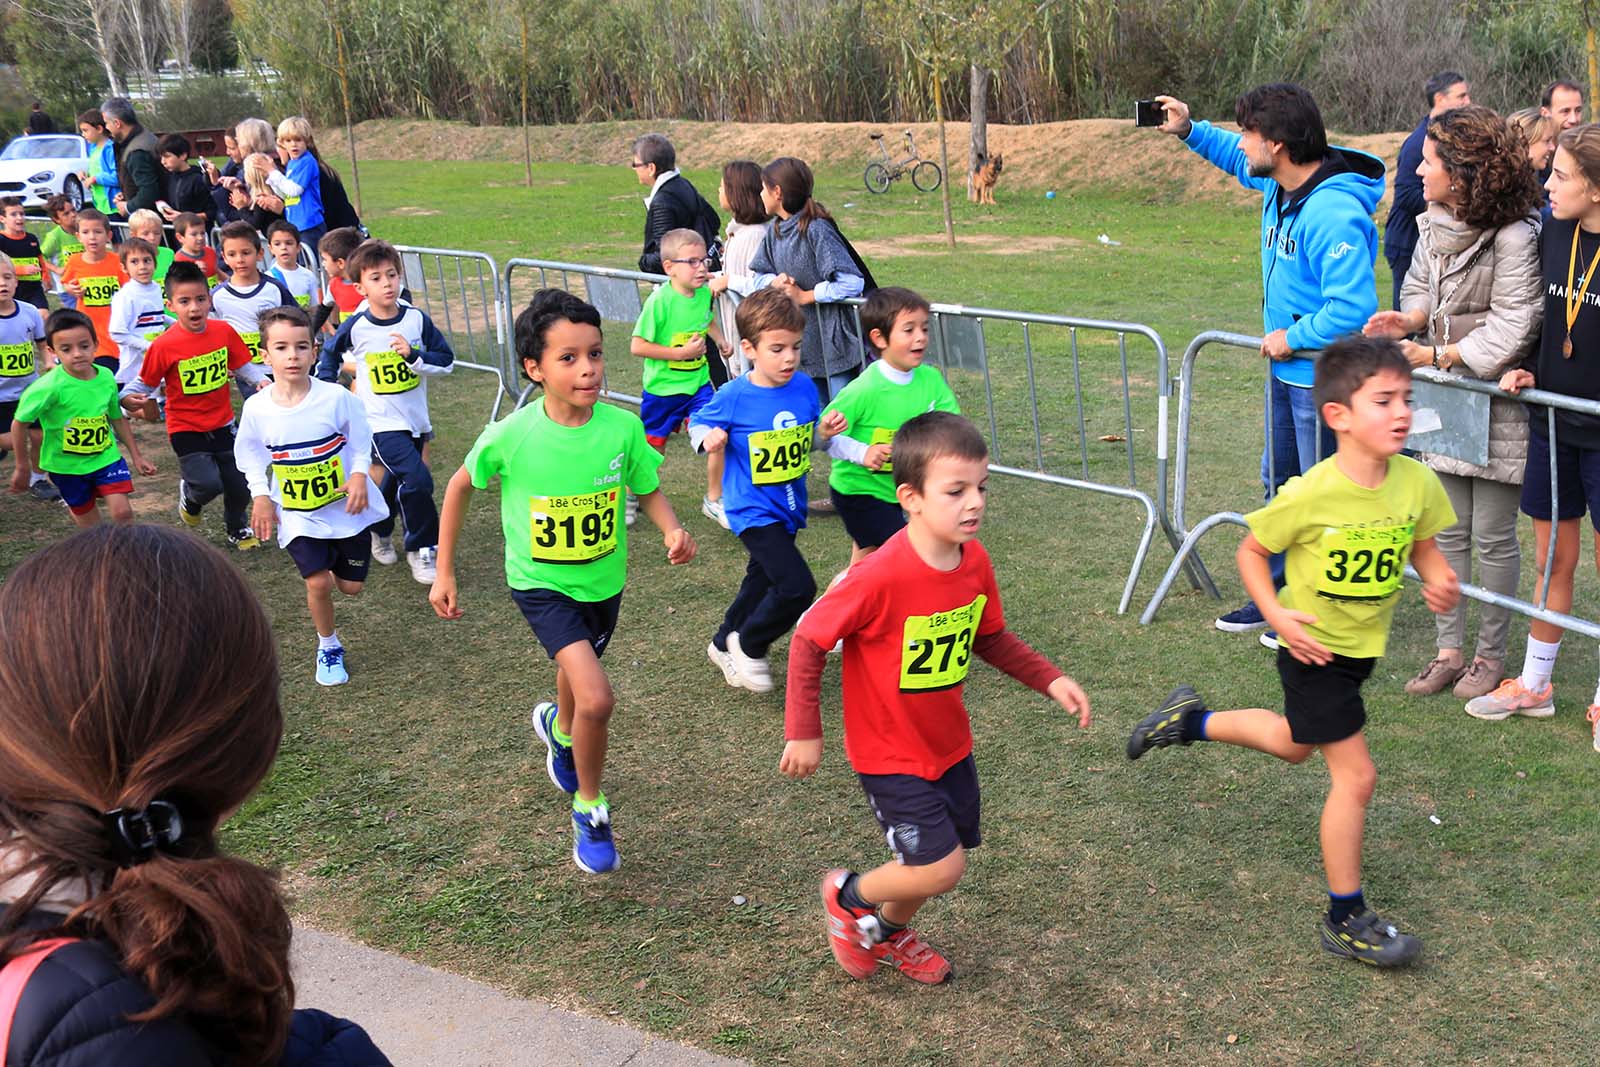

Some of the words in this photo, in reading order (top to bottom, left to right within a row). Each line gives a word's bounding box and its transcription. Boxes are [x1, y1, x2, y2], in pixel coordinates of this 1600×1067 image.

[1548, 283, 1600, 307] MAHTTA
[183, 359, 226, 387] 2725
[772, 410, 798, 430] G
[283, 470, 339, 500] 4761
[572, 497, 593, 507] Cros
[535, 508, 614, 548] 3193
[907, 628, 971, 674] 273
